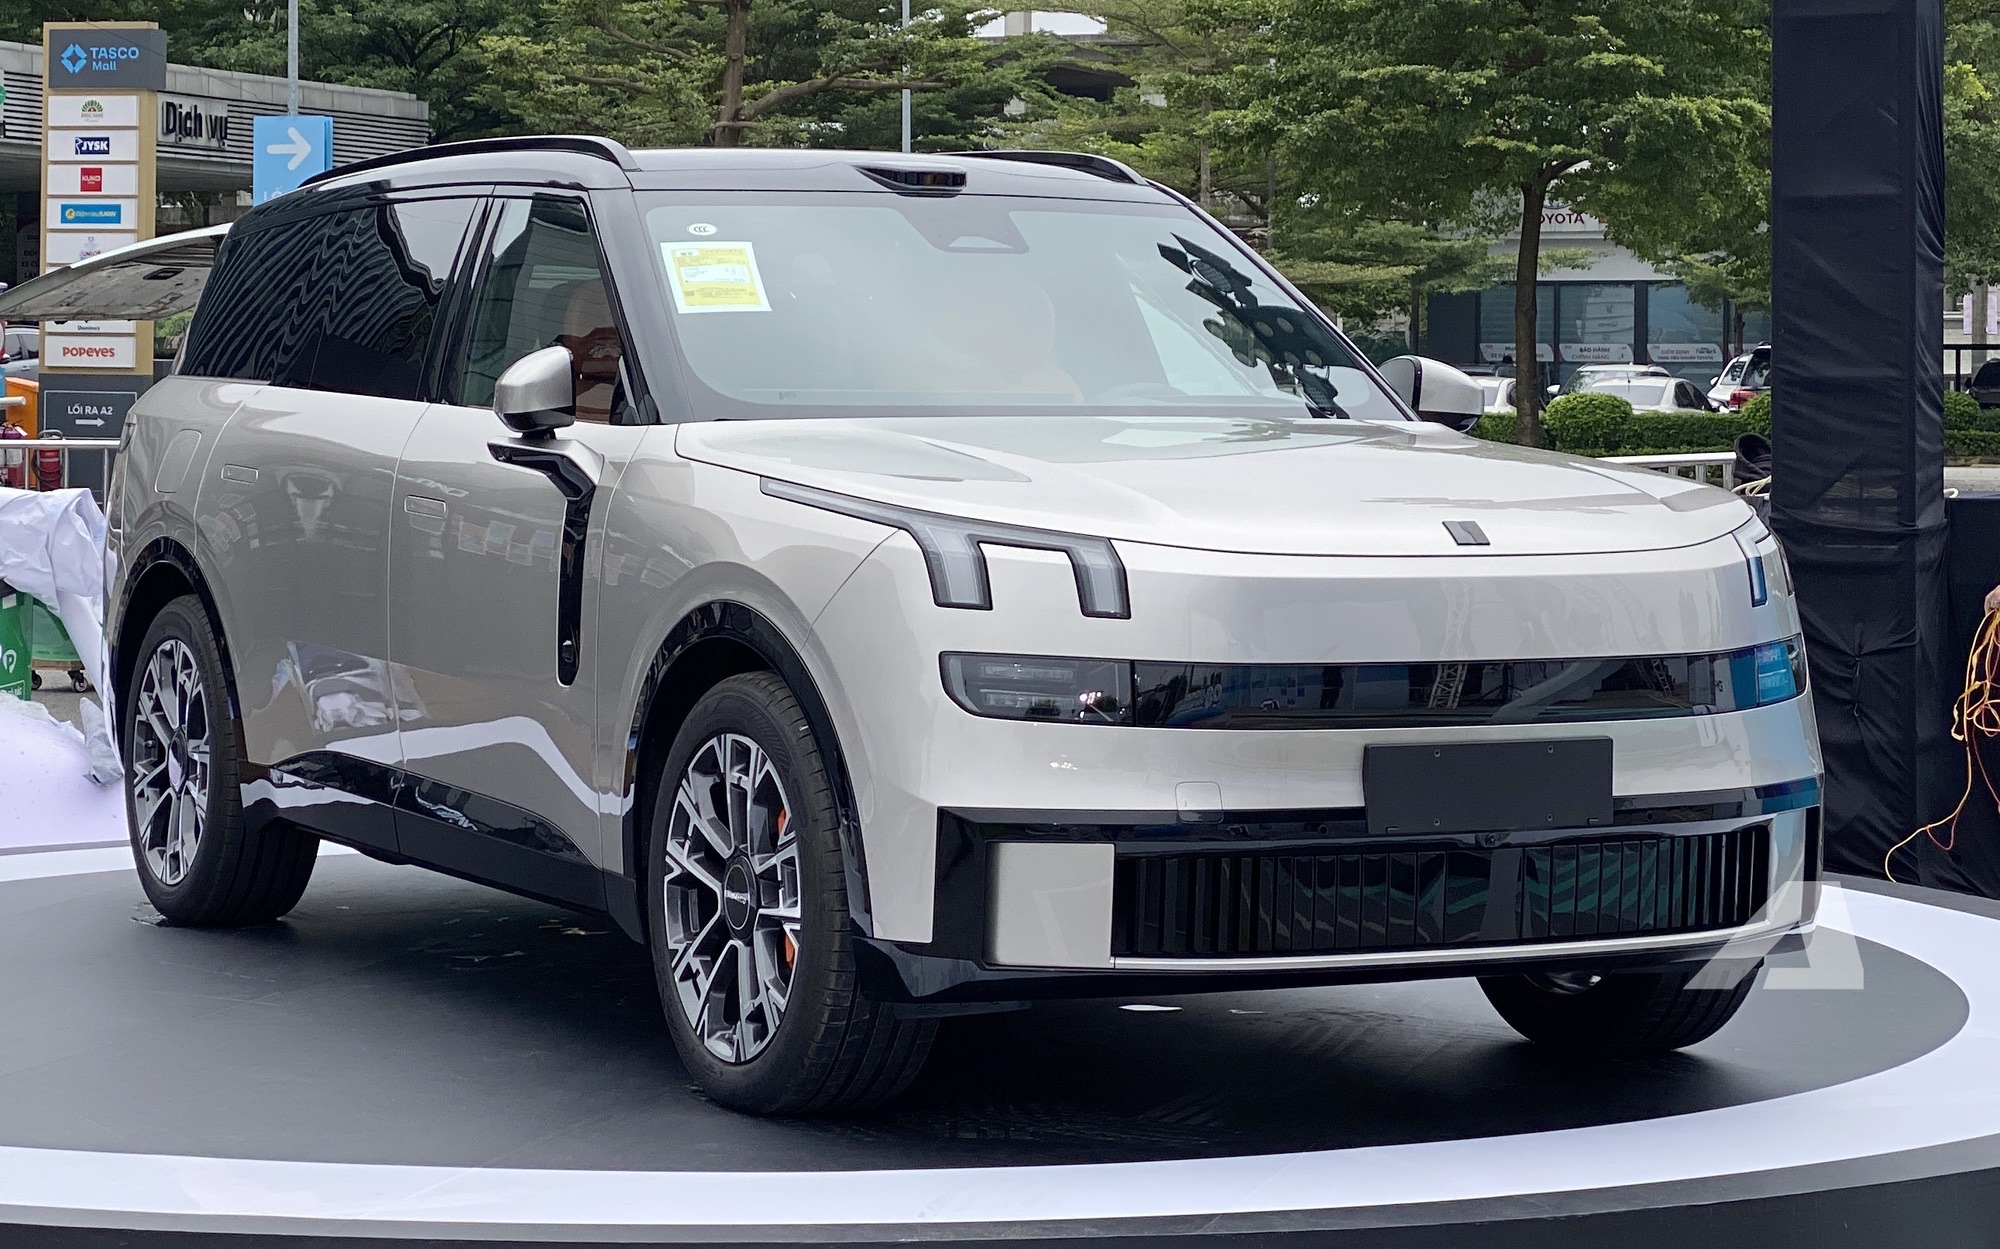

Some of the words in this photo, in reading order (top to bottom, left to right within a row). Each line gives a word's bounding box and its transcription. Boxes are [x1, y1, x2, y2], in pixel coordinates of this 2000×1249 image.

[90, 47, 139, 59] TASCO
[92, 61, 117, 71] Mall
[162, 101, 203, 143] Dịch
[206, 114, 228, 148] vụ
[81, 141, 108, 151] JYSK
[1540, 213, 1585, 224] YOTA
[67, 403, 83, 415] LỐI
[85, 406, 99, 415] RA
[101, 406, 113, 415] A2
